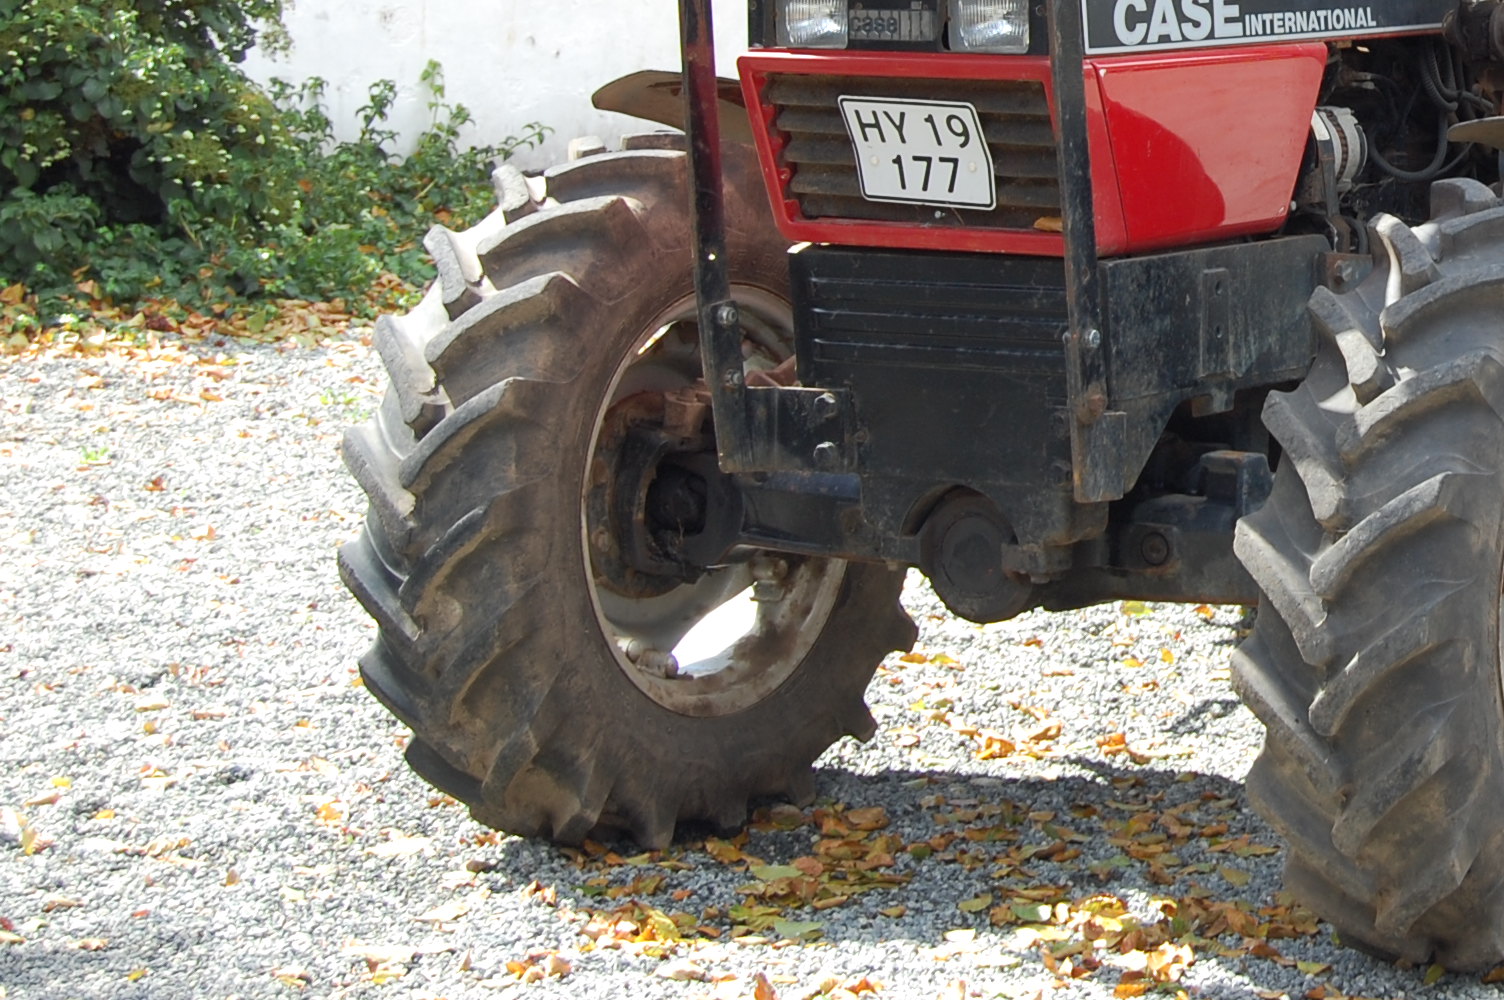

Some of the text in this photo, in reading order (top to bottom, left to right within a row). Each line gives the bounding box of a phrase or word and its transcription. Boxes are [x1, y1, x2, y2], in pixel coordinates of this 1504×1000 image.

[1244, 6, 1377, 36] INTERNATIONAL
[854, 109, 971, 149] HY 19
[891, 154, 960, 194] 177
